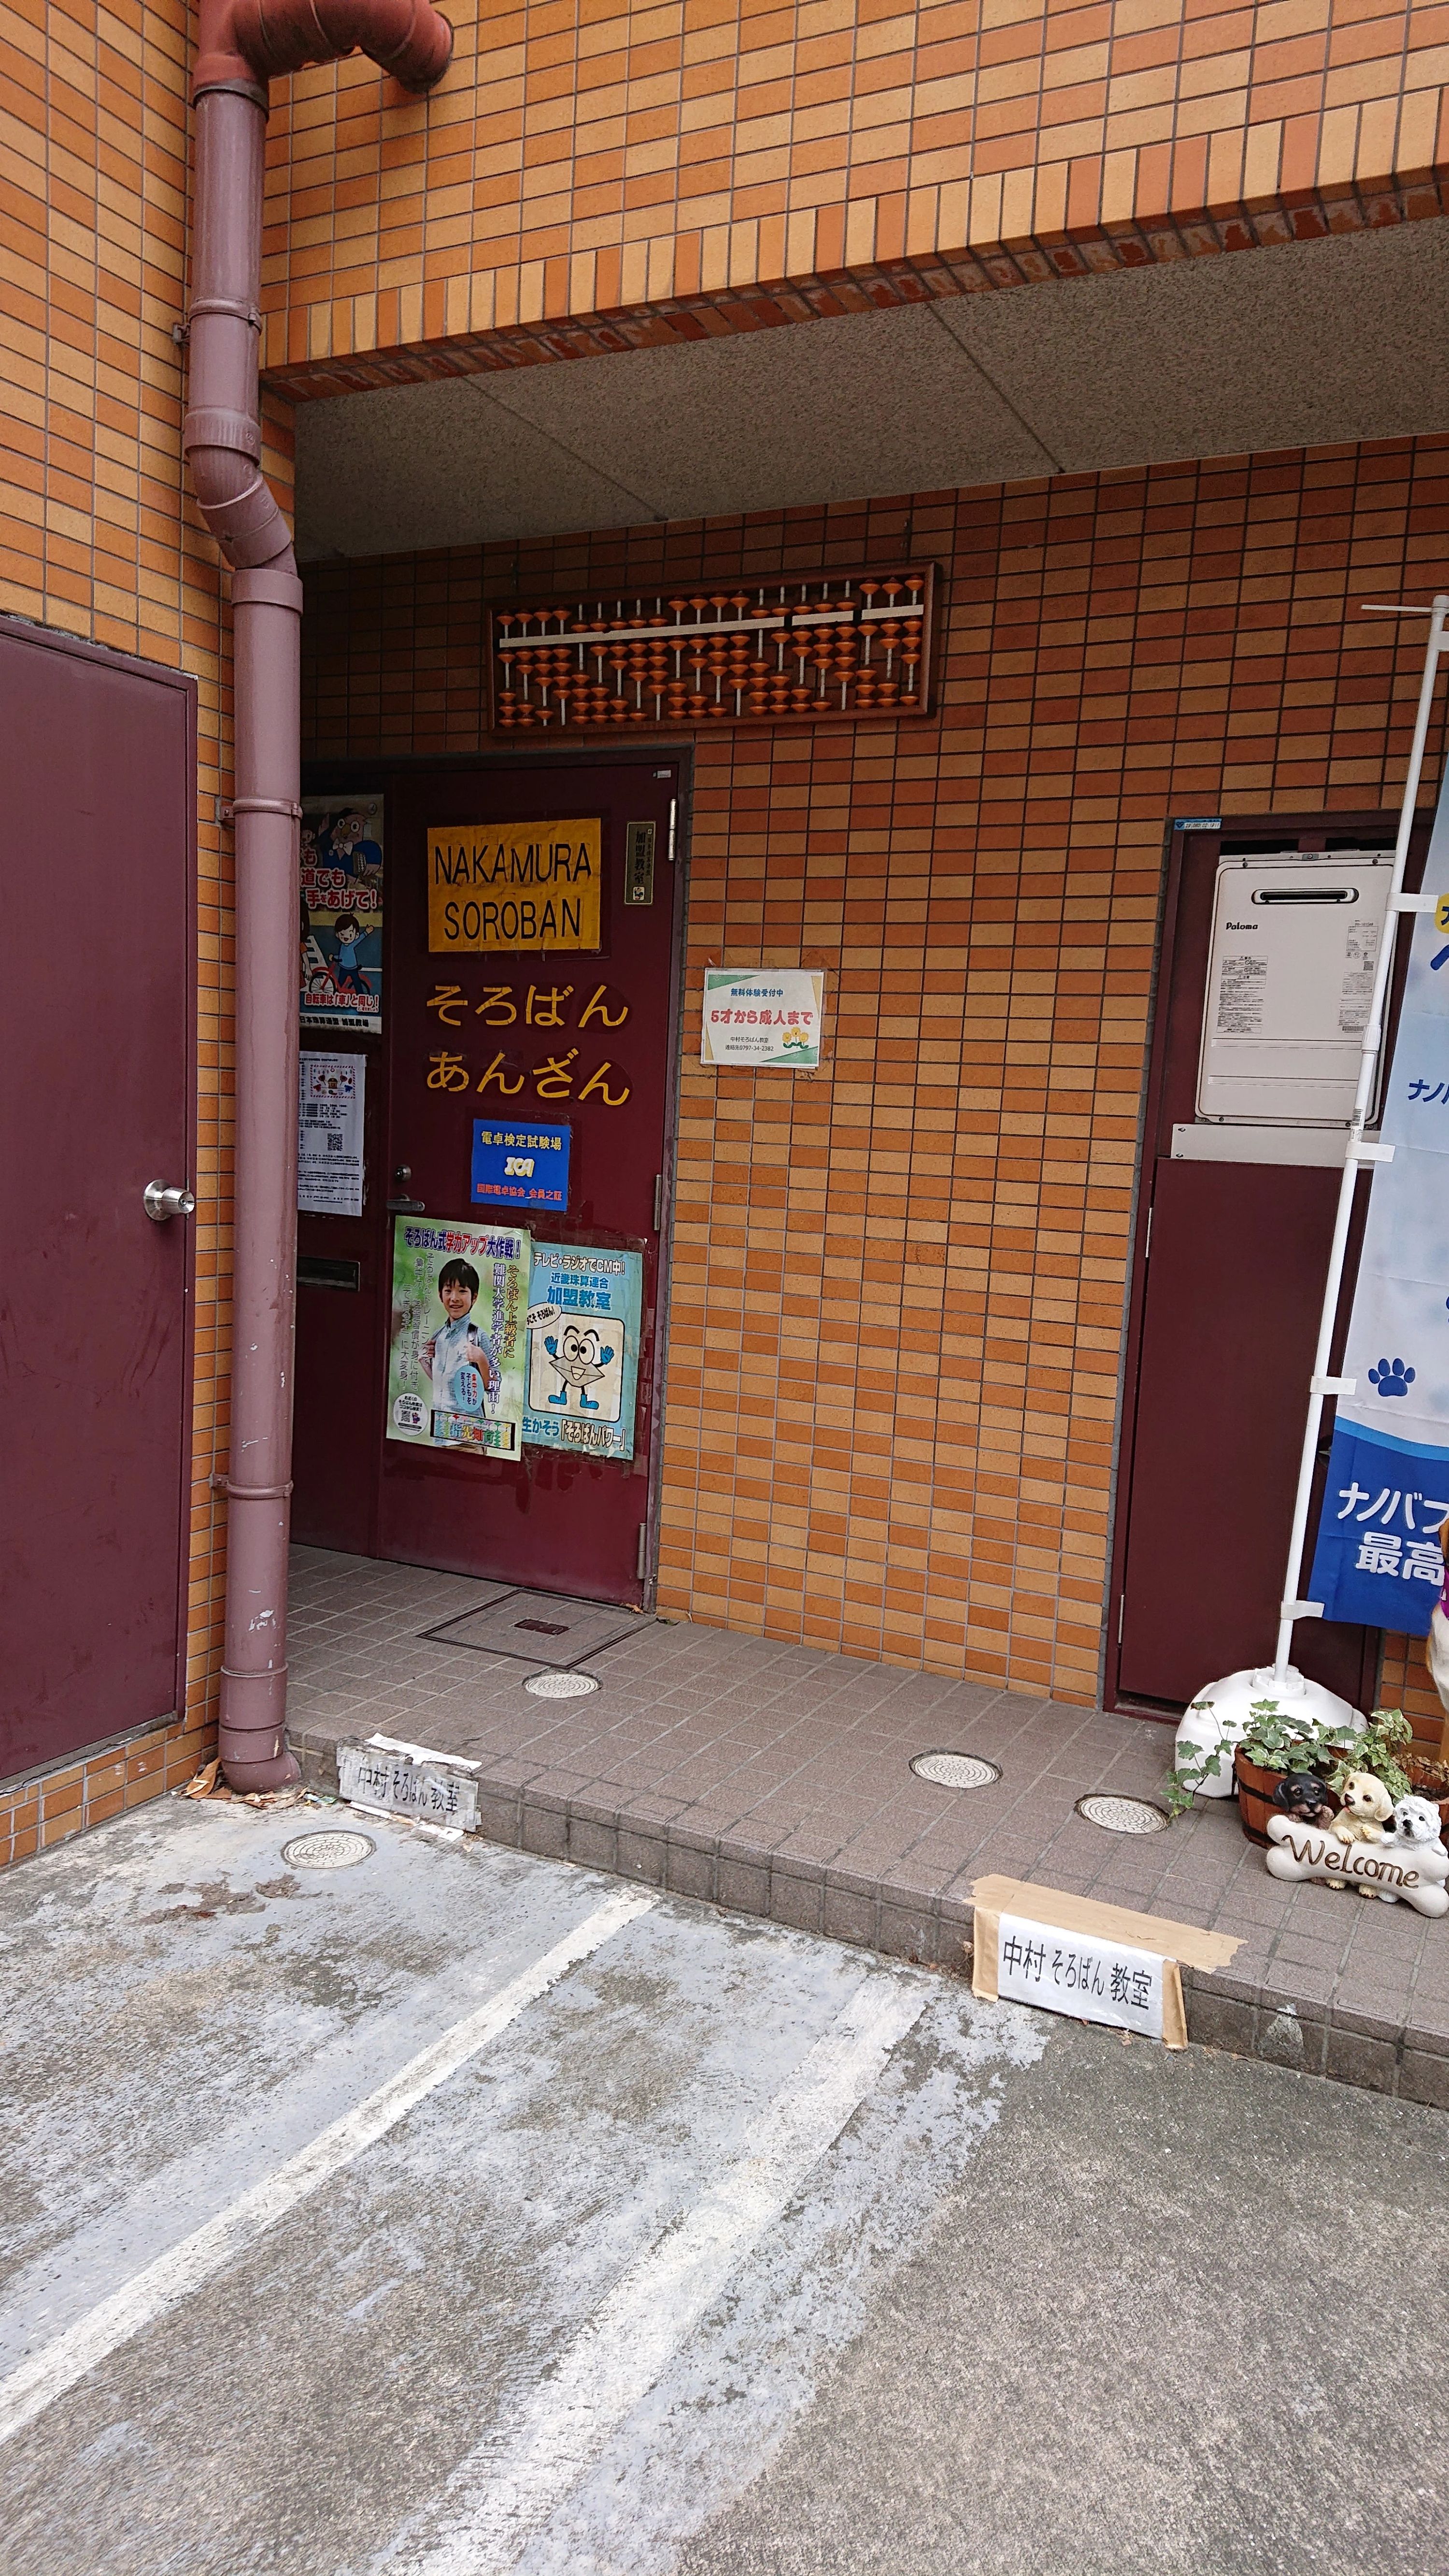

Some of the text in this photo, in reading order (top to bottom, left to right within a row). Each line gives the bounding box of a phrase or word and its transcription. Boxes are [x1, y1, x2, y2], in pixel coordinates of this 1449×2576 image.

[301, 868, 345, 886] 道でも
[435, 842, 592, 884] NAKAMURA
[634, 831, 646, 884] 加盟教室
[444, 898, 581, 940] SOROBAN
[1226, 922, 1258, 930] Paloma
[426, 985, 628, 1028] そろばん
[731, 988, 783, 997] 無料体験受付中
[711, 1009, 813, 1025] 5才から成人まで
[426, 1048, 630, 1106] あんざん
[1407, 1079, 1449, 1105] ナノ
[481, 1131, 562, 1150] 電卓検定試験場
[547, 1286, 611, 1310] 加盟教室
[551, 1272, 609, 1289] 近畿珠算連合
[502, 1265, 520, 1358] そろばん上級者に
[1355, 1530, 1446, 1586] 最高
[1281, 1834, 1420, 1889] Welcome
[1003, 1935, 1152, 2010] 中村 そろばん 教室
